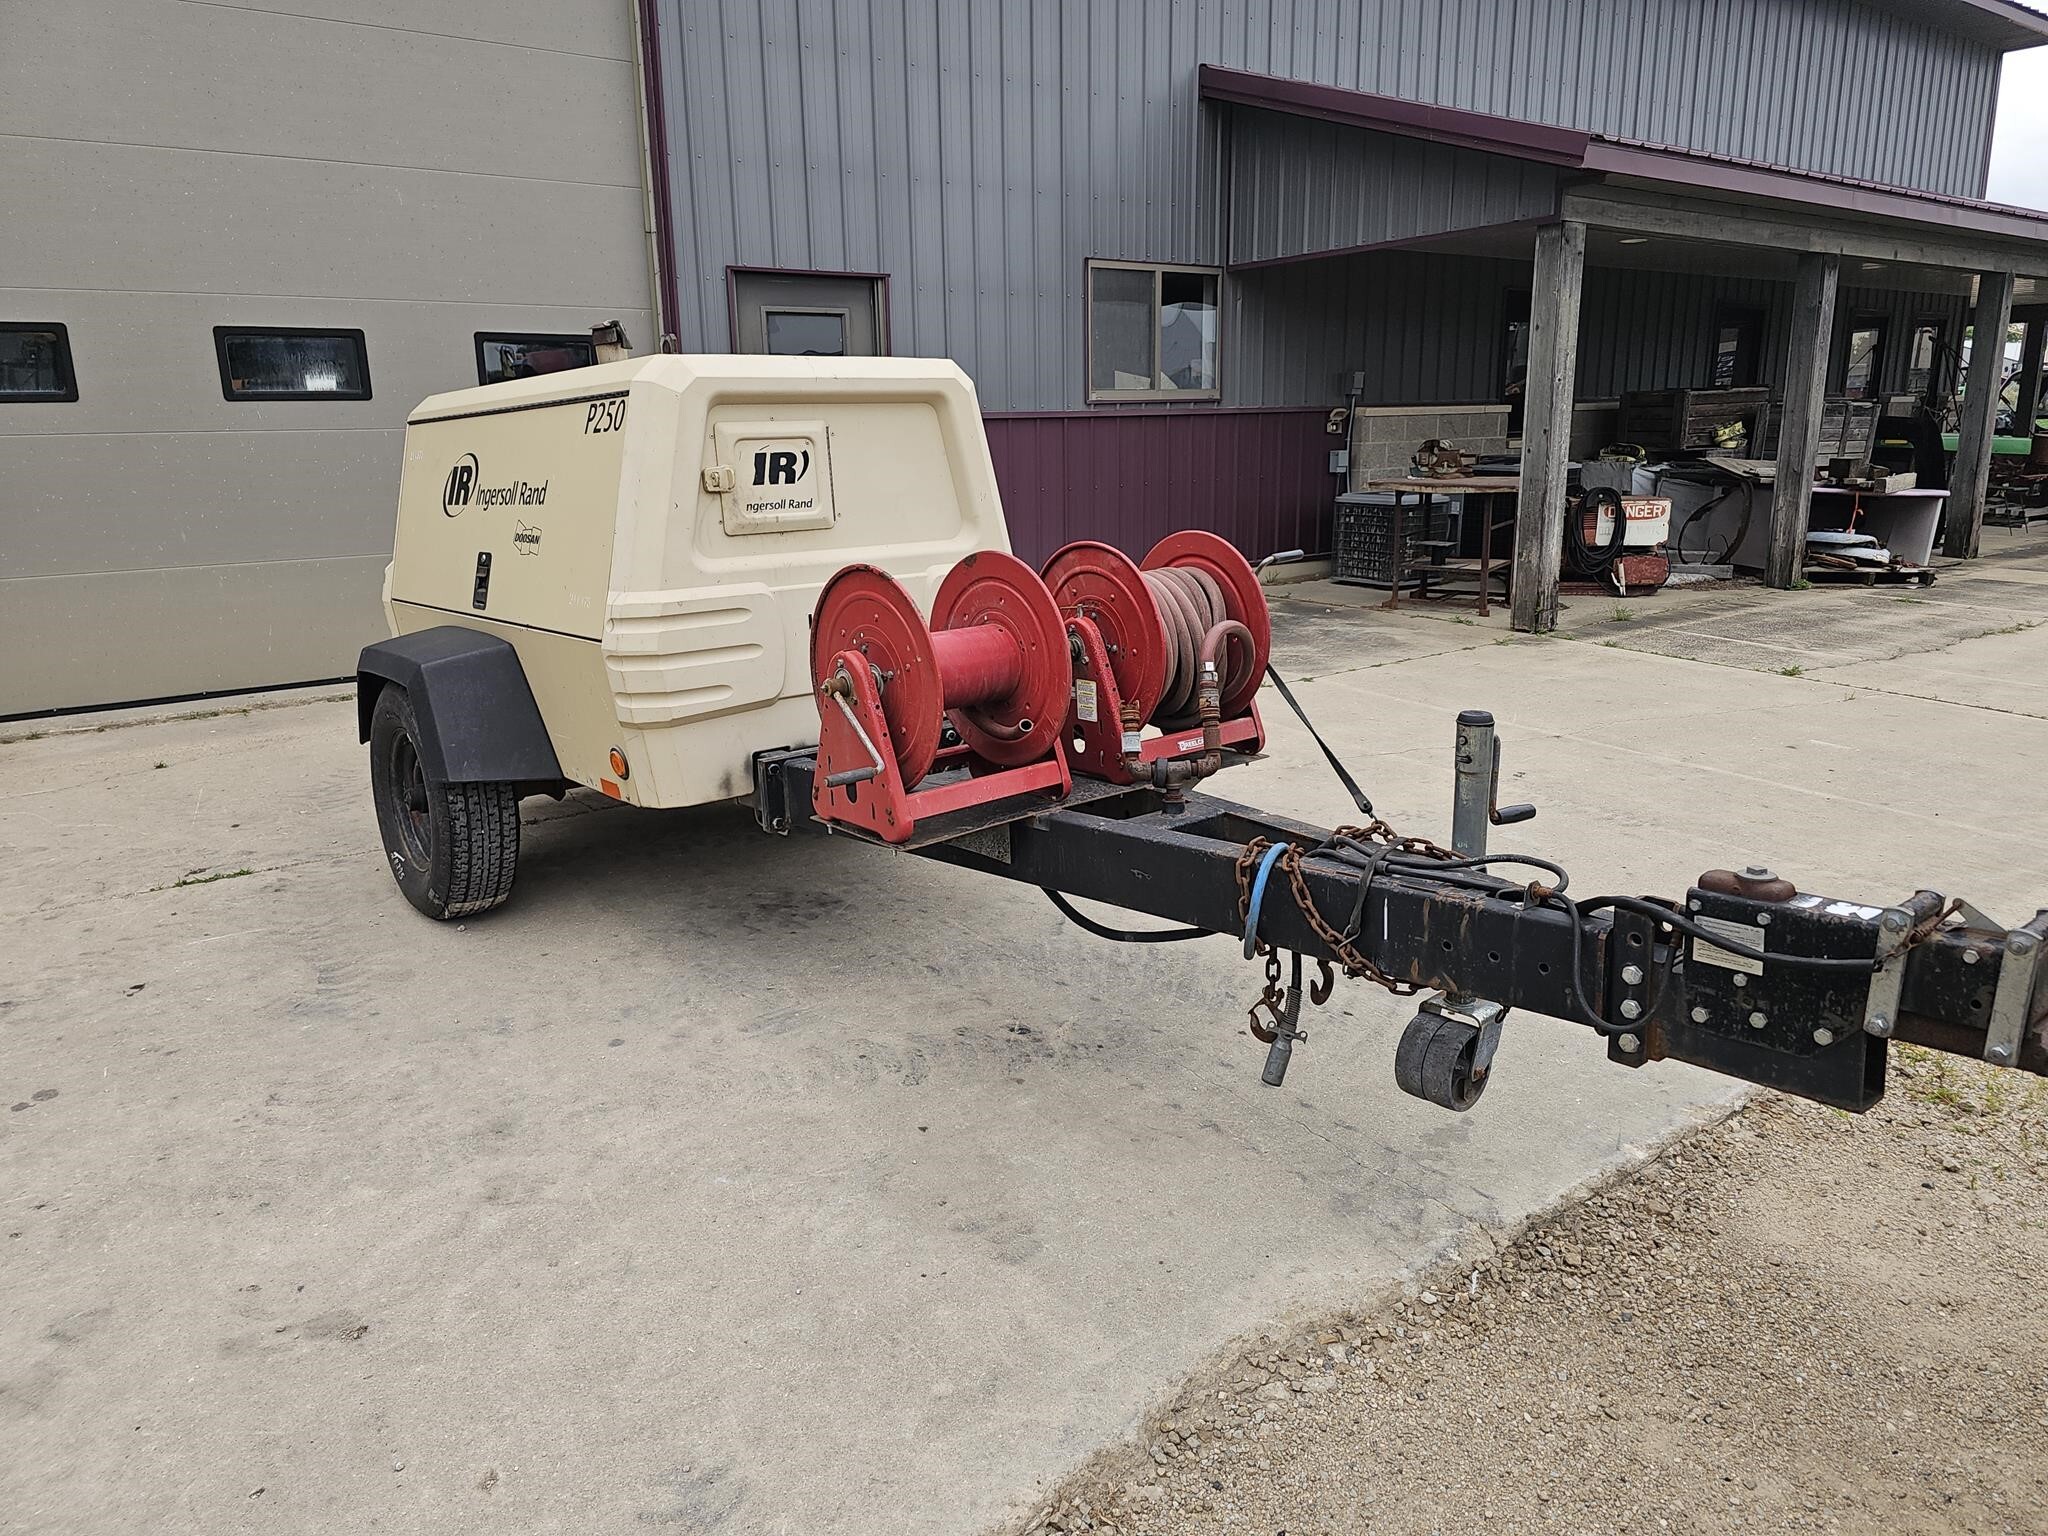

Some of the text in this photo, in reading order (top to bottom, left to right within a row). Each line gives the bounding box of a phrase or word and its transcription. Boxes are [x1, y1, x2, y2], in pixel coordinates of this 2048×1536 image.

[584, 399, 626, 434] P250
[752, 451, 798, 486] IR
[447, 465, 473, 506] IR
[475, 479, 549, 511] Ingersoll Rand
[788, 497, 813, 509] Rand
[1607, 504, 1663, 518] DNGER
[514, 532, 541, 545] DOOSAN
